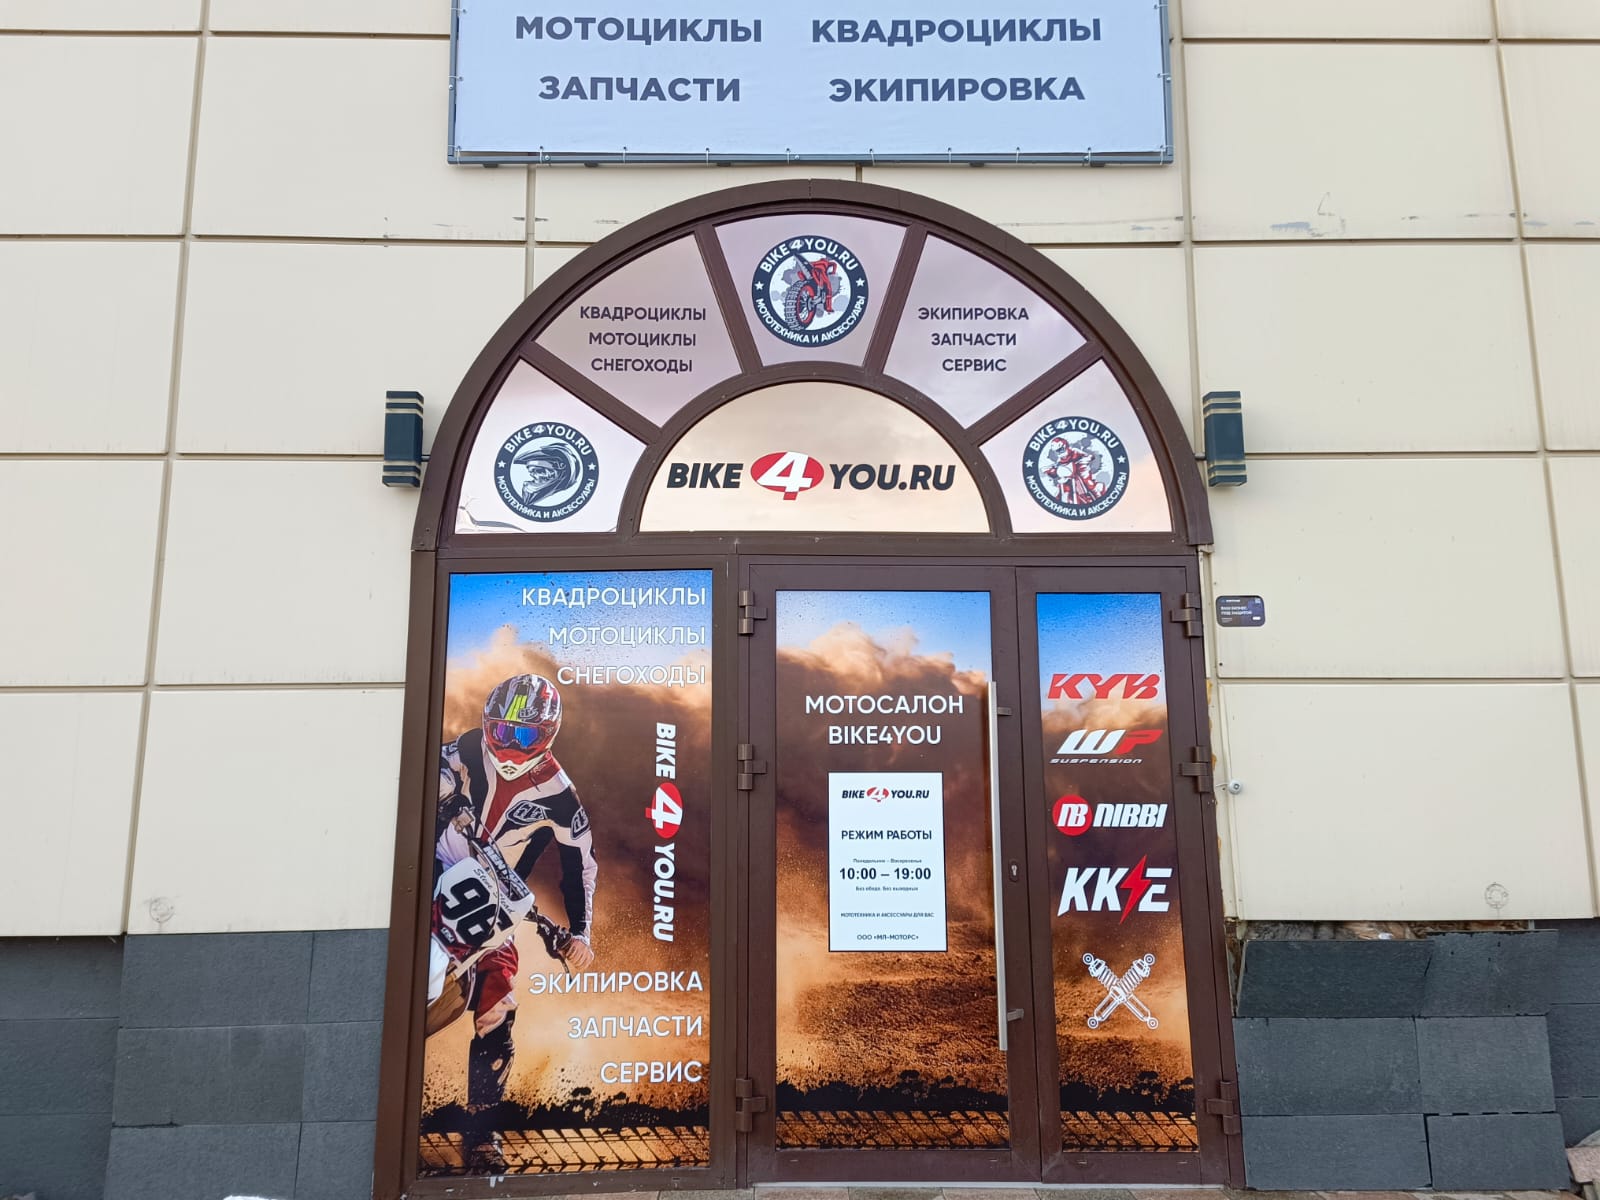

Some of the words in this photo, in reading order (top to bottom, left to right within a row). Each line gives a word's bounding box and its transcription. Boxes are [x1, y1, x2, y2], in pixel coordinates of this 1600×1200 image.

[515, 15, 762, 45] МОТОЦИКЛЫ
[811, 17, 1102, 46] КВАДРОЦИКЛЫ
[538, 75, 741, 102] ЗАПЧАСТИ
[828, 76, 1085, 102] ЭКИПИРОВКА
[580, 306, 706, 322] КВАДРОЦИКЛЫ
[755, 298, 810, 344] МОТОТЕХНИКА
[811, 335, 820, 344] И
[821, 295, 866, 343] АКСЕССУАРЫ
[917, 307, 1030, 321] ЭКИПИРОВКА
[589, 332, 696, 347] МОТОЦИКЛЫ
[930, 332, 1017, 346] ЗАПЧАСТИ
[591, 358, 693, 374] СНЕГОХОДЫ
[942, 358, 1007, 372] СЕРВИС
[496, 475, 542, 518] МОТОТЕХНИКА
[543, 510, 550, 518] И
[551, 478, 595, 518] АКСЕССУАРЫ
[1026, 474, 1078, 517] МОТОТЕХНИКА
[1079, 508, 1087, 517] И
[1087, 471, 1128, 516] АКСЕССУАРЫ
[522, 586, 706, 608] КВАДРОЦИКЛЫ
[549, 626, 706, 648] МОТОЦИКЛЫ
[556, 665, 706, 688] СНЕГОХОДЫ
[1047, 673, 1161, 700] KYB
[805, 694, 964, 714] МОТОСАЛОН
[828, 725, 942, 745] BIKE4YOU
[1092, 803, 1168, 828] NIBBI
[841, 830, 884, 840] РЕЖИМ
[886, 830, 933, 840] РАБОТЫ
[840, 867, 877, 880] 10:00
[894, 867, 932, 880] 19:00
[439, 877, 514, 951] 96
[529, 970, 703, 994] ЭКИПИРОВКА
[568, 1015, 702, 1039] ЗАПЧАСТИ
[600, 1061, 702, 1084] СЕРВИС
